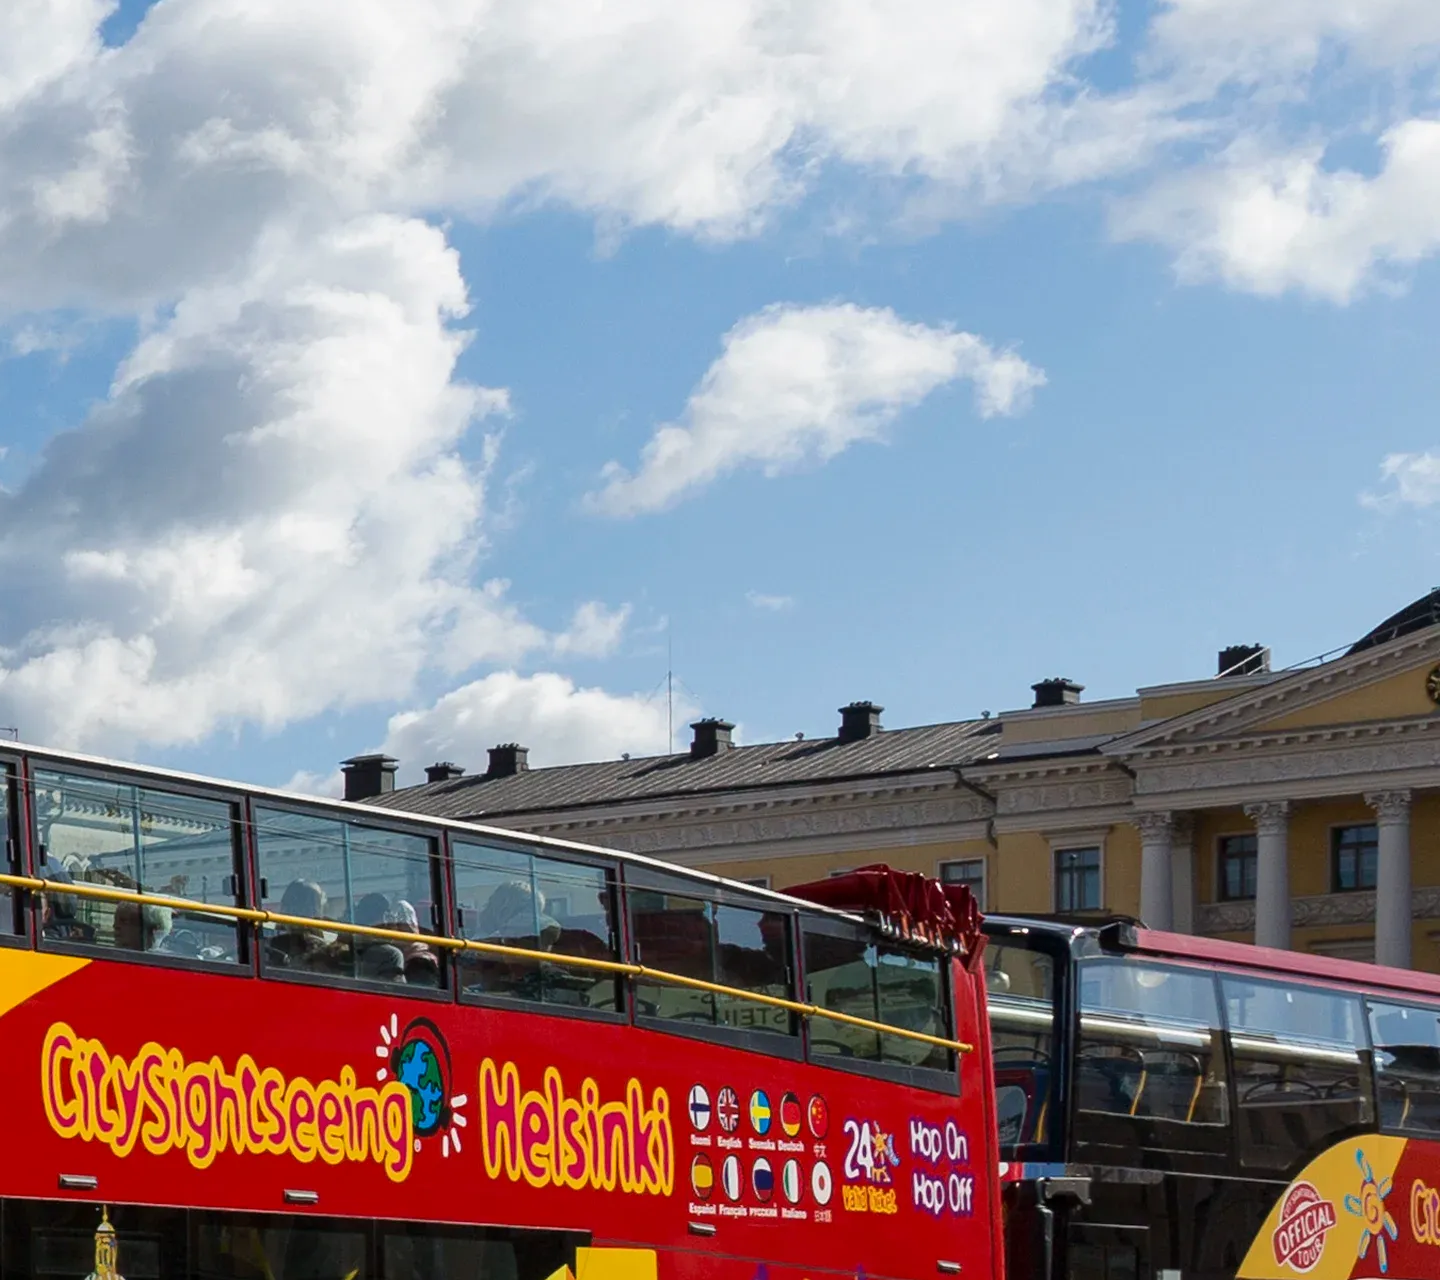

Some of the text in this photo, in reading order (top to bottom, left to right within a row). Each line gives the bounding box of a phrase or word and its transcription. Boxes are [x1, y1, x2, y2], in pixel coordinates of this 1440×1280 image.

[480, 1058, 674, 1196] Helsinki
[690, 1134, 805, 1152] Suomi English Svenska Deutsch
[910, 1120, 968, 1162] Hop On
[844, 1120, 874, 1179] 24
[781, 1207, 807, 1220] Italiano
[913, 1172, 973, 1215] Hop Off
[1279, 1204, 1334, 1256] OFFICIAL
[1297, 1238, 1322, 1266] TOUR
